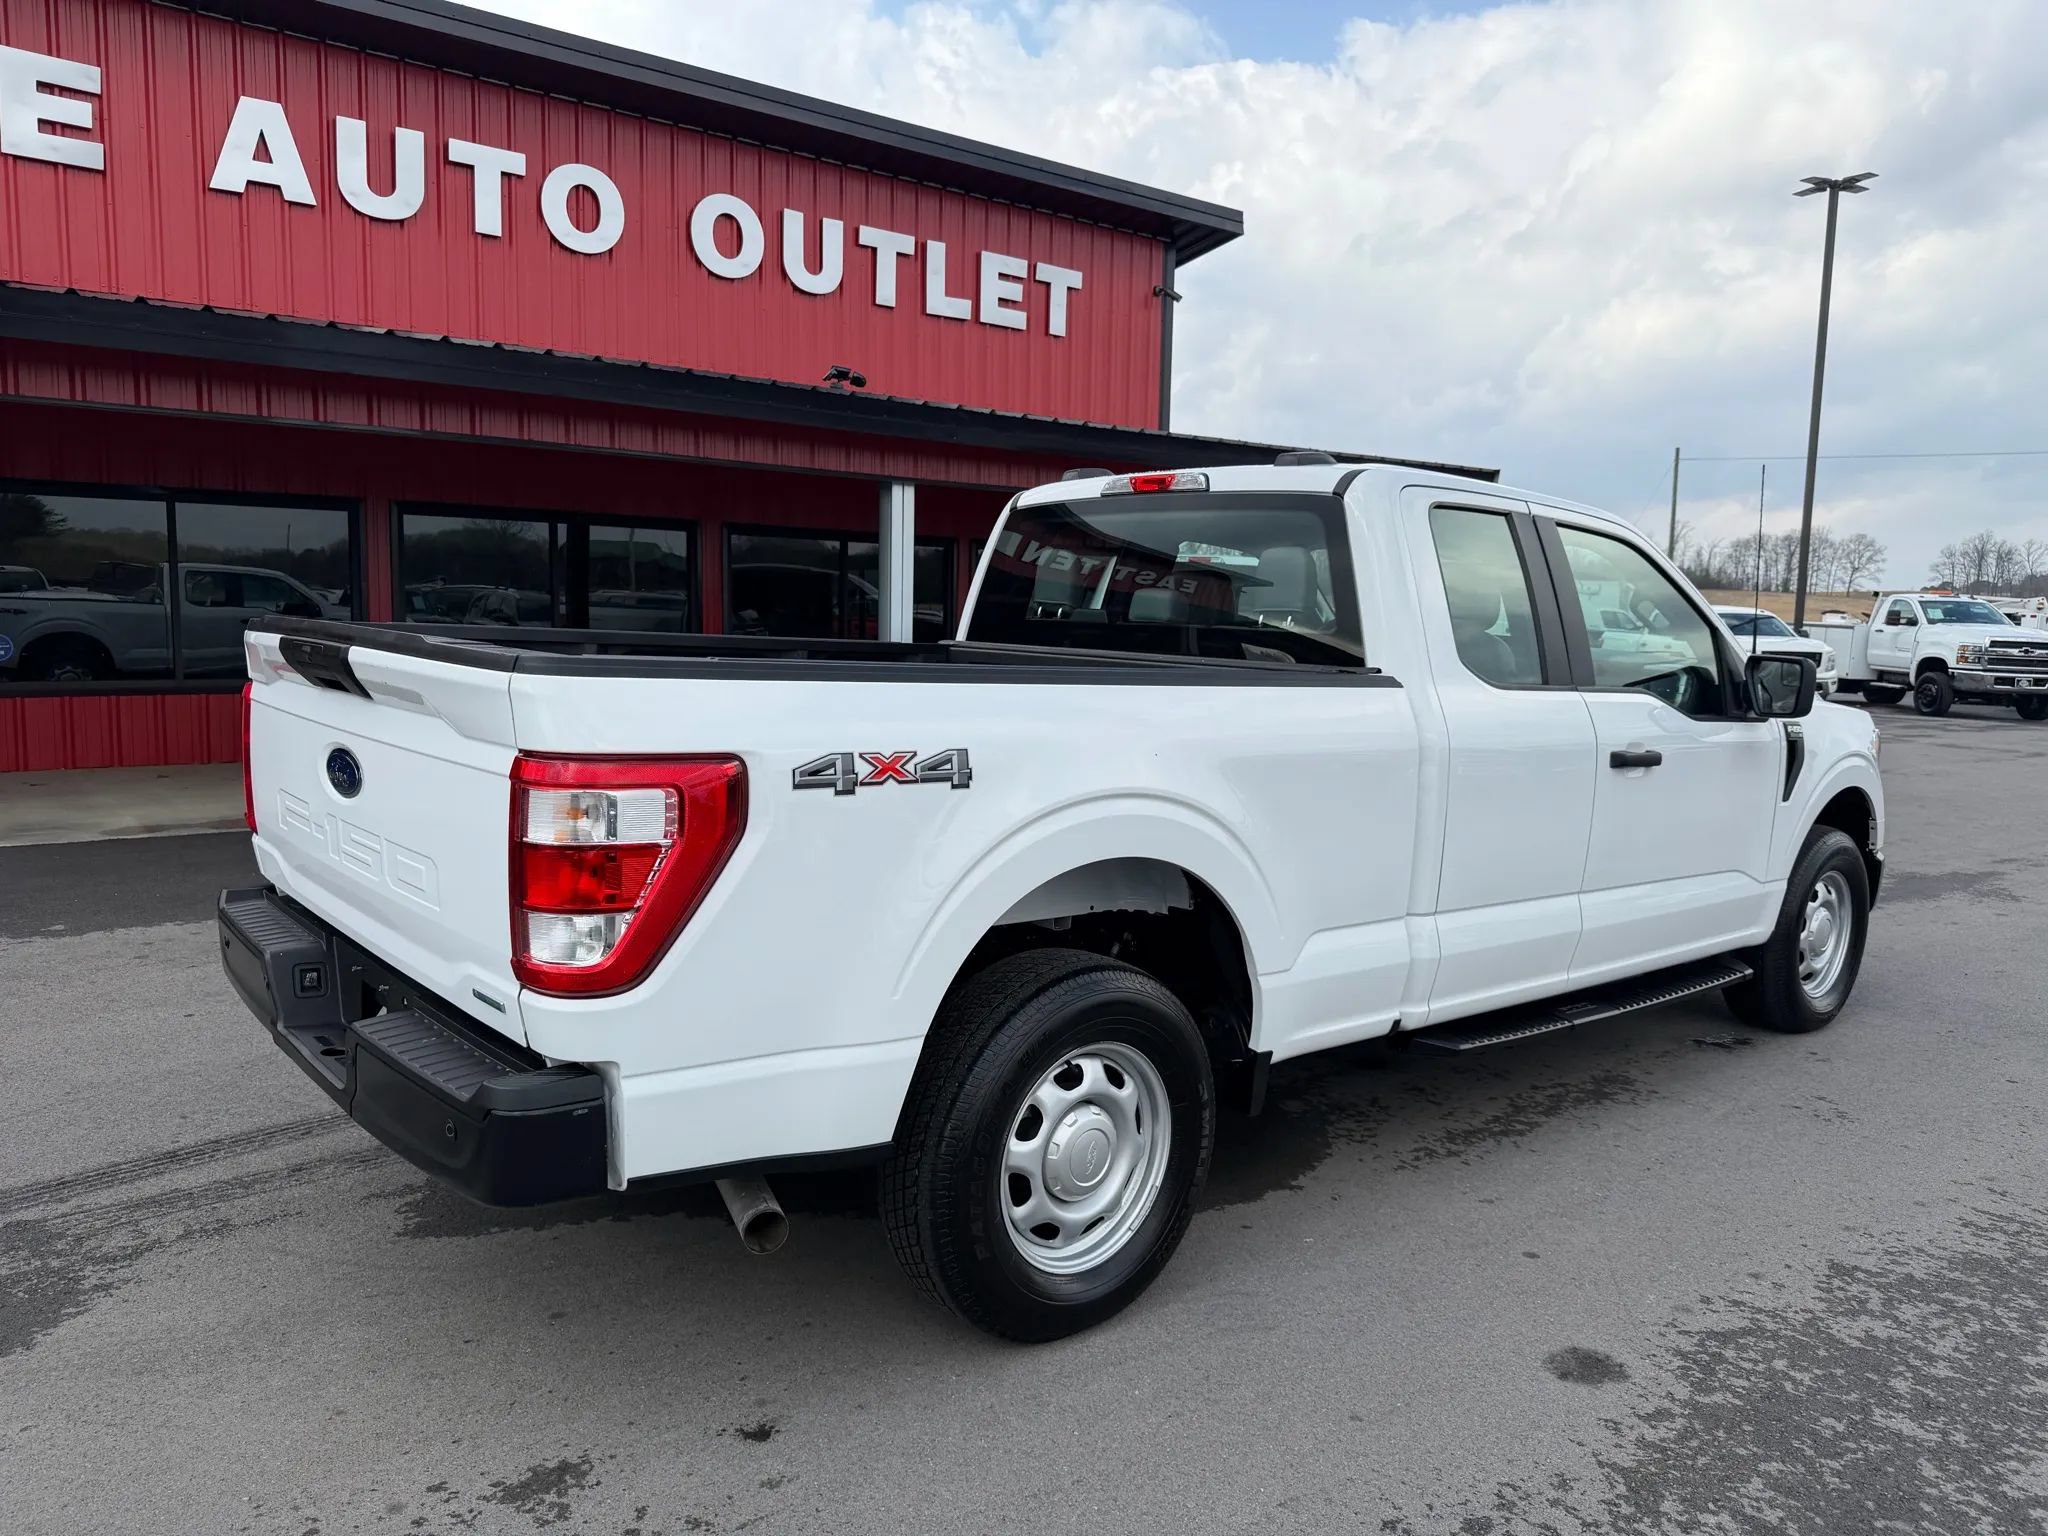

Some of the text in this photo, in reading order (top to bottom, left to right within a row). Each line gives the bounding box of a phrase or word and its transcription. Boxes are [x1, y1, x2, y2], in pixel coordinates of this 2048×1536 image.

[209, 95, 625, 255] AUTO
[690, 192, 1083, 338] OUTLET
[792, 748, 973, 796] 4X4
[277, 788, 441, 912] F-150
